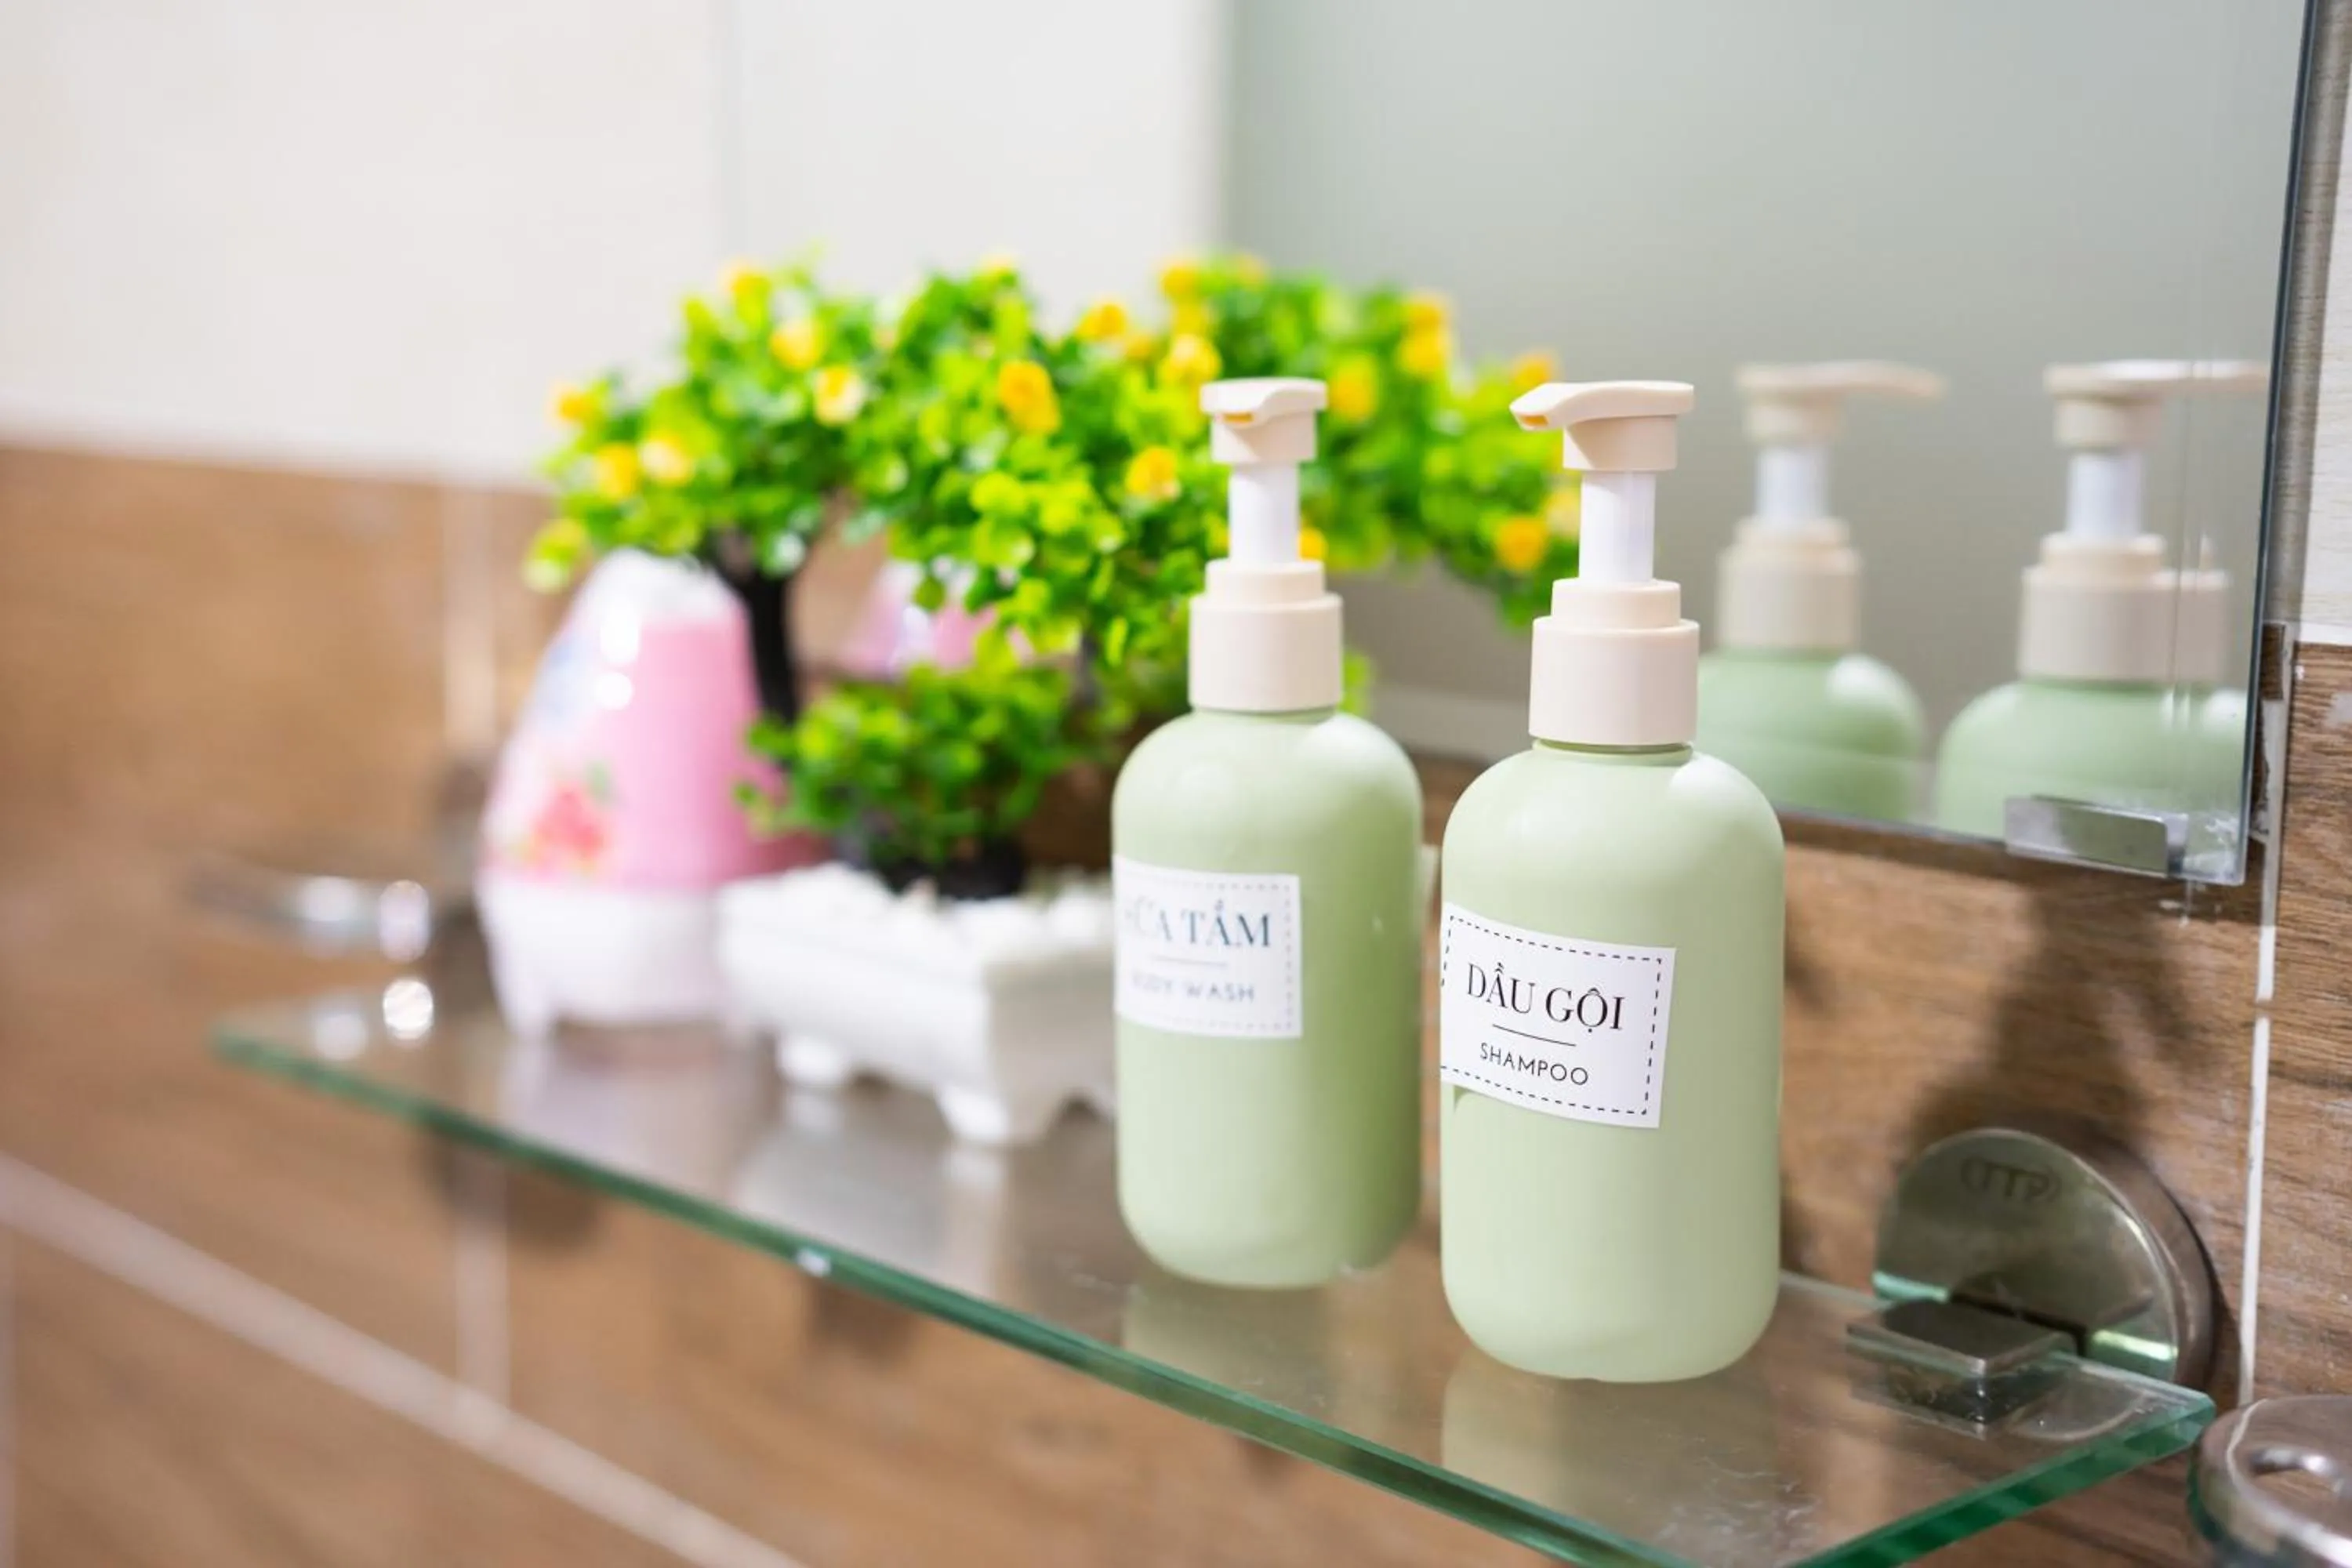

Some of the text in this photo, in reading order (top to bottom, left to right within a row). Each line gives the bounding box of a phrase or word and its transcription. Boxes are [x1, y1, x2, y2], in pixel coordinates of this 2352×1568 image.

[1185, 981, 1255, 1004] WASH
[1467, 962, 1624, 1033] DẦU GỘI
[1480, 1042, 1589, 1086] SHAMPOO
